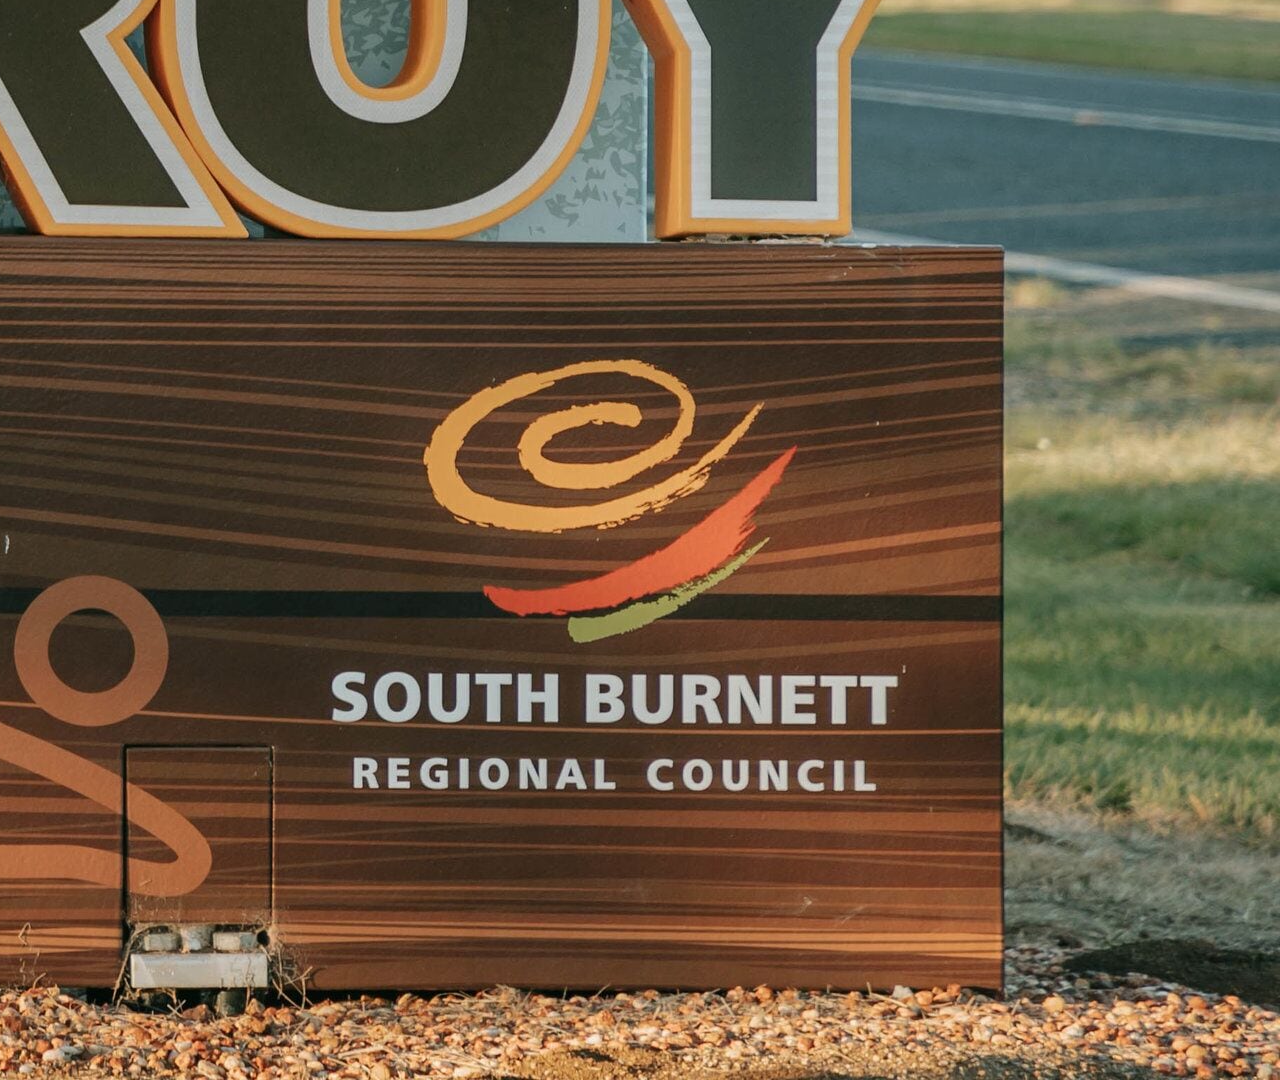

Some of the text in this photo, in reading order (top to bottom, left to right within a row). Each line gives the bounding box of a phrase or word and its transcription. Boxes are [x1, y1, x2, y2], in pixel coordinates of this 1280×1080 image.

[330, 670, 899, 726] SOUTH BURNETT
[352, 756, 878, 793] REGIONAL COUNCIL
